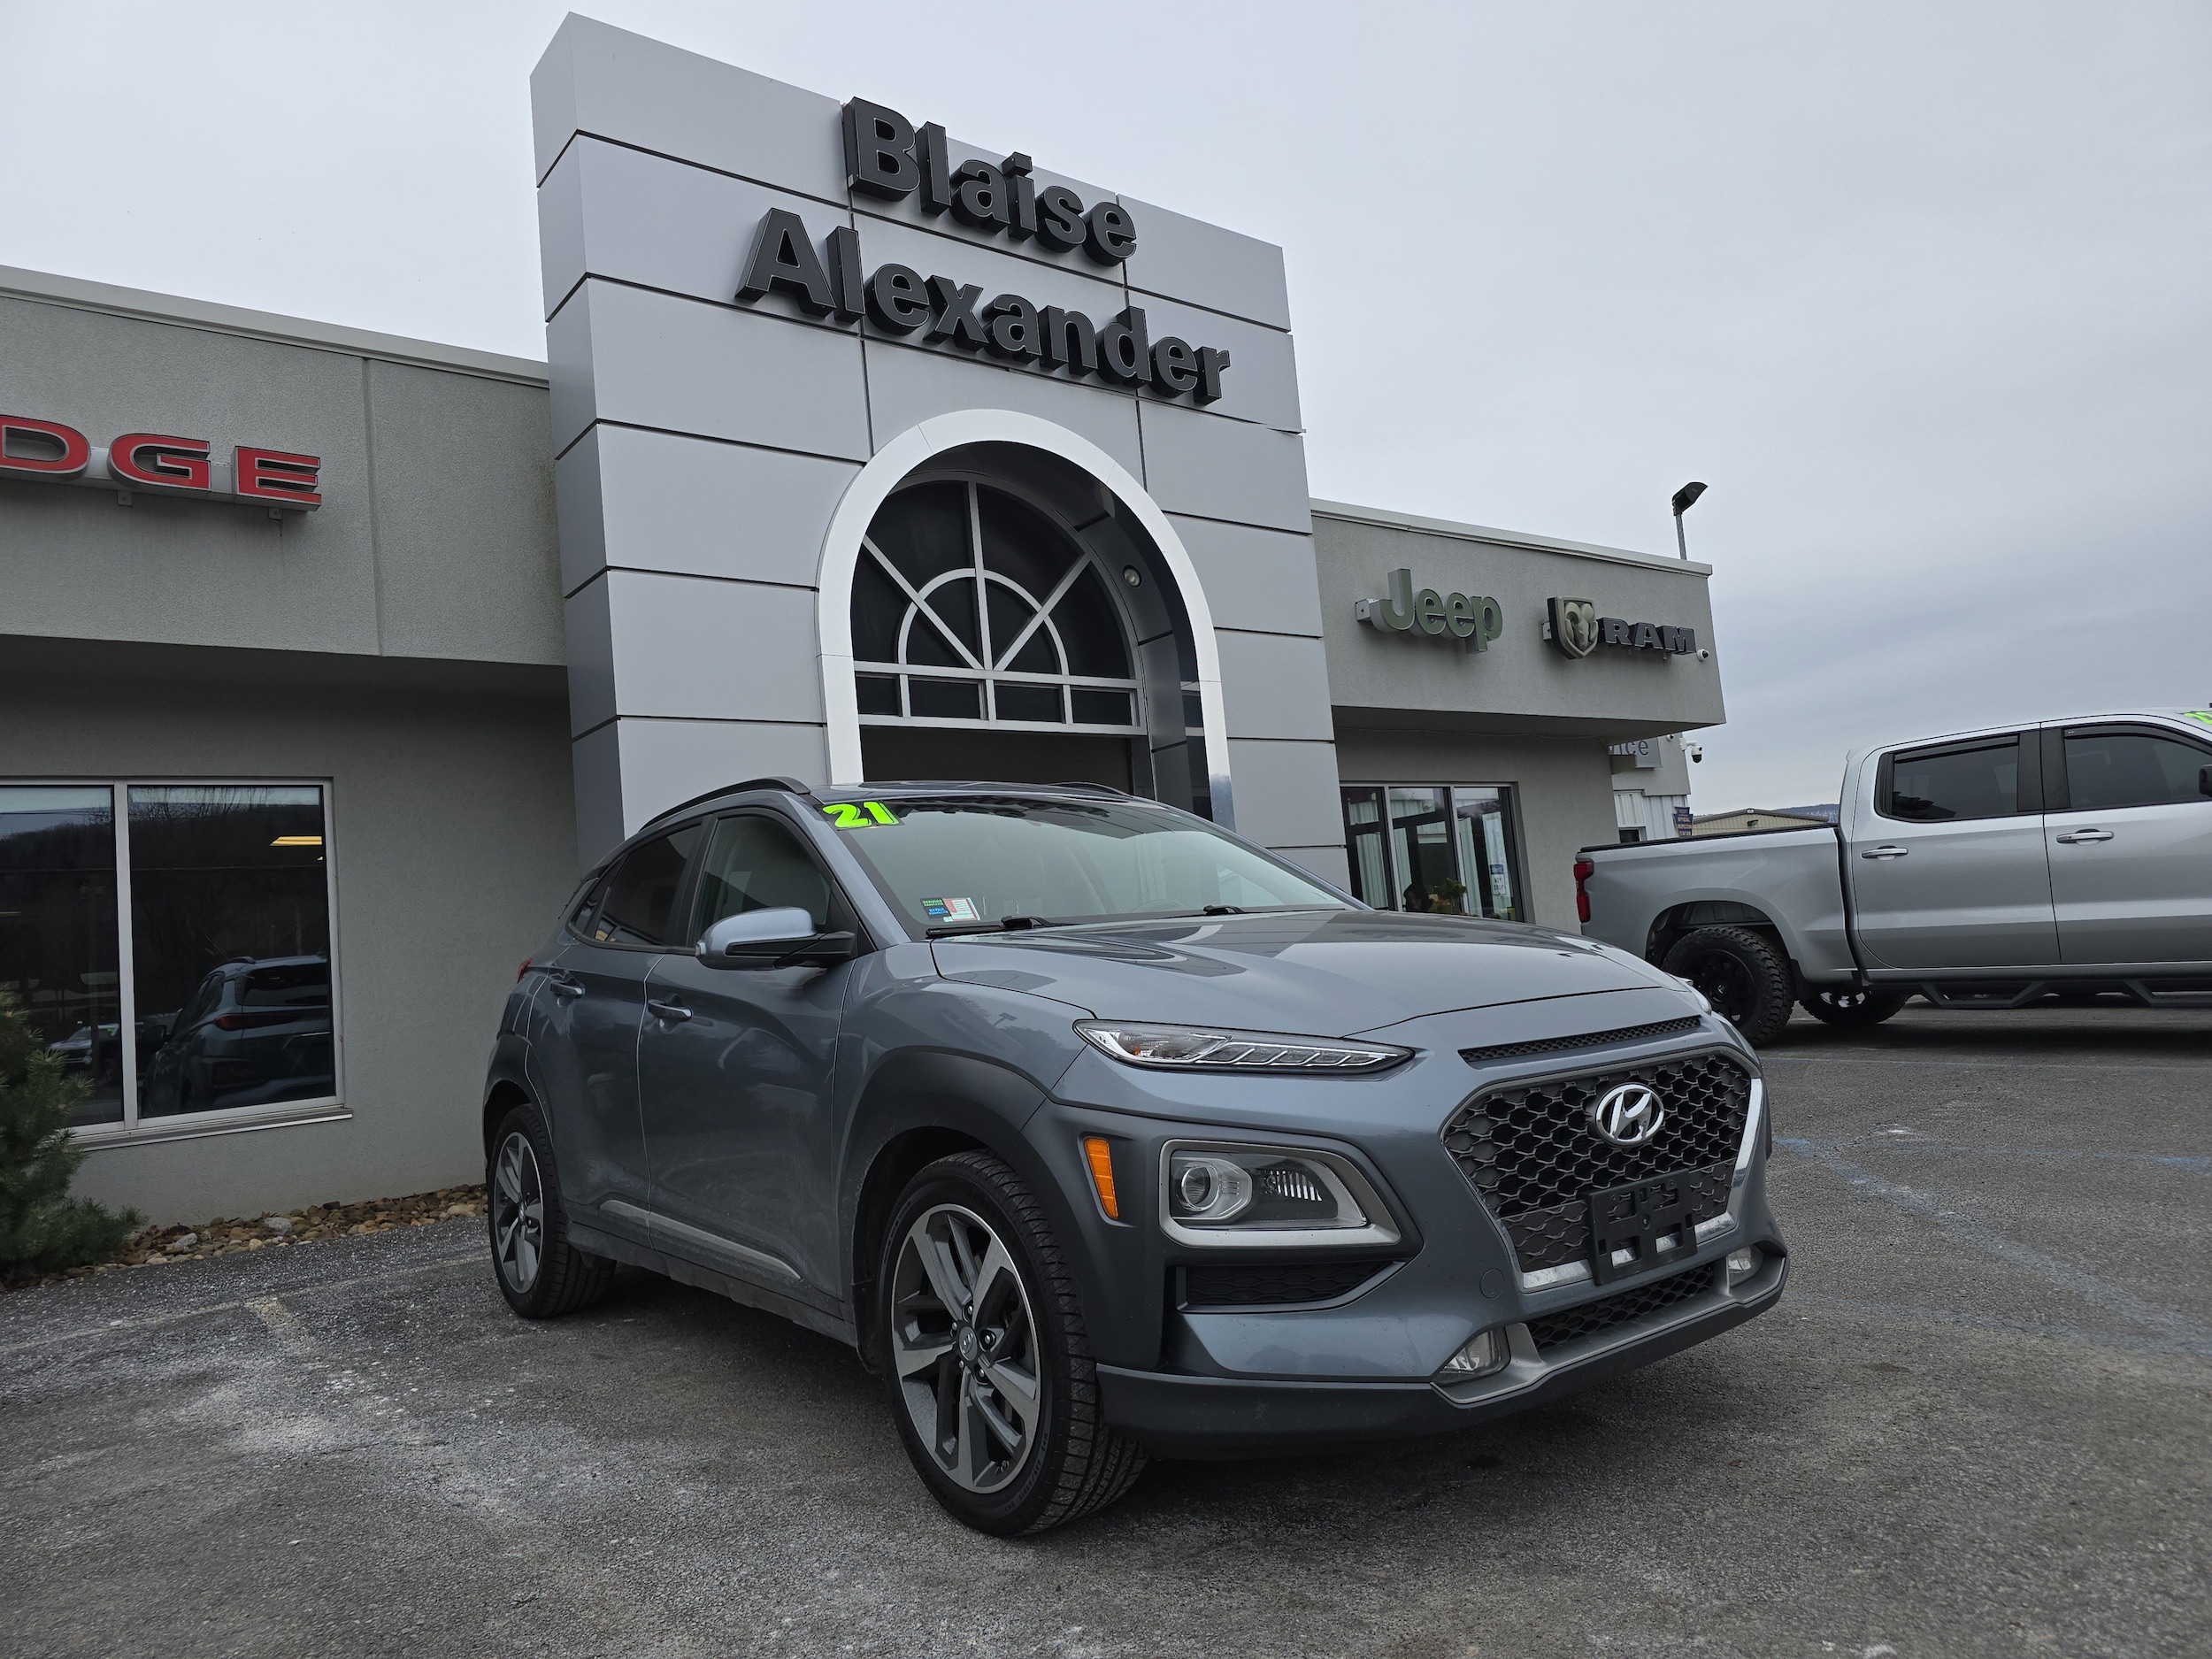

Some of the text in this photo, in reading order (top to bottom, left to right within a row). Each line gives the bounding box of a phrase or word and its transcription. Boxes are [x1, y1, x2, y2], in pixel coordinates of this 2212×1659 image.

[842, 96, 1137, 265] Blaise
[735, 208, 1231, 404] Alexander
[1371, 568, 1502, 654] Jeep
[1597, 617, 1696, 655] RAM
[822, 801, 900, 829] 21
